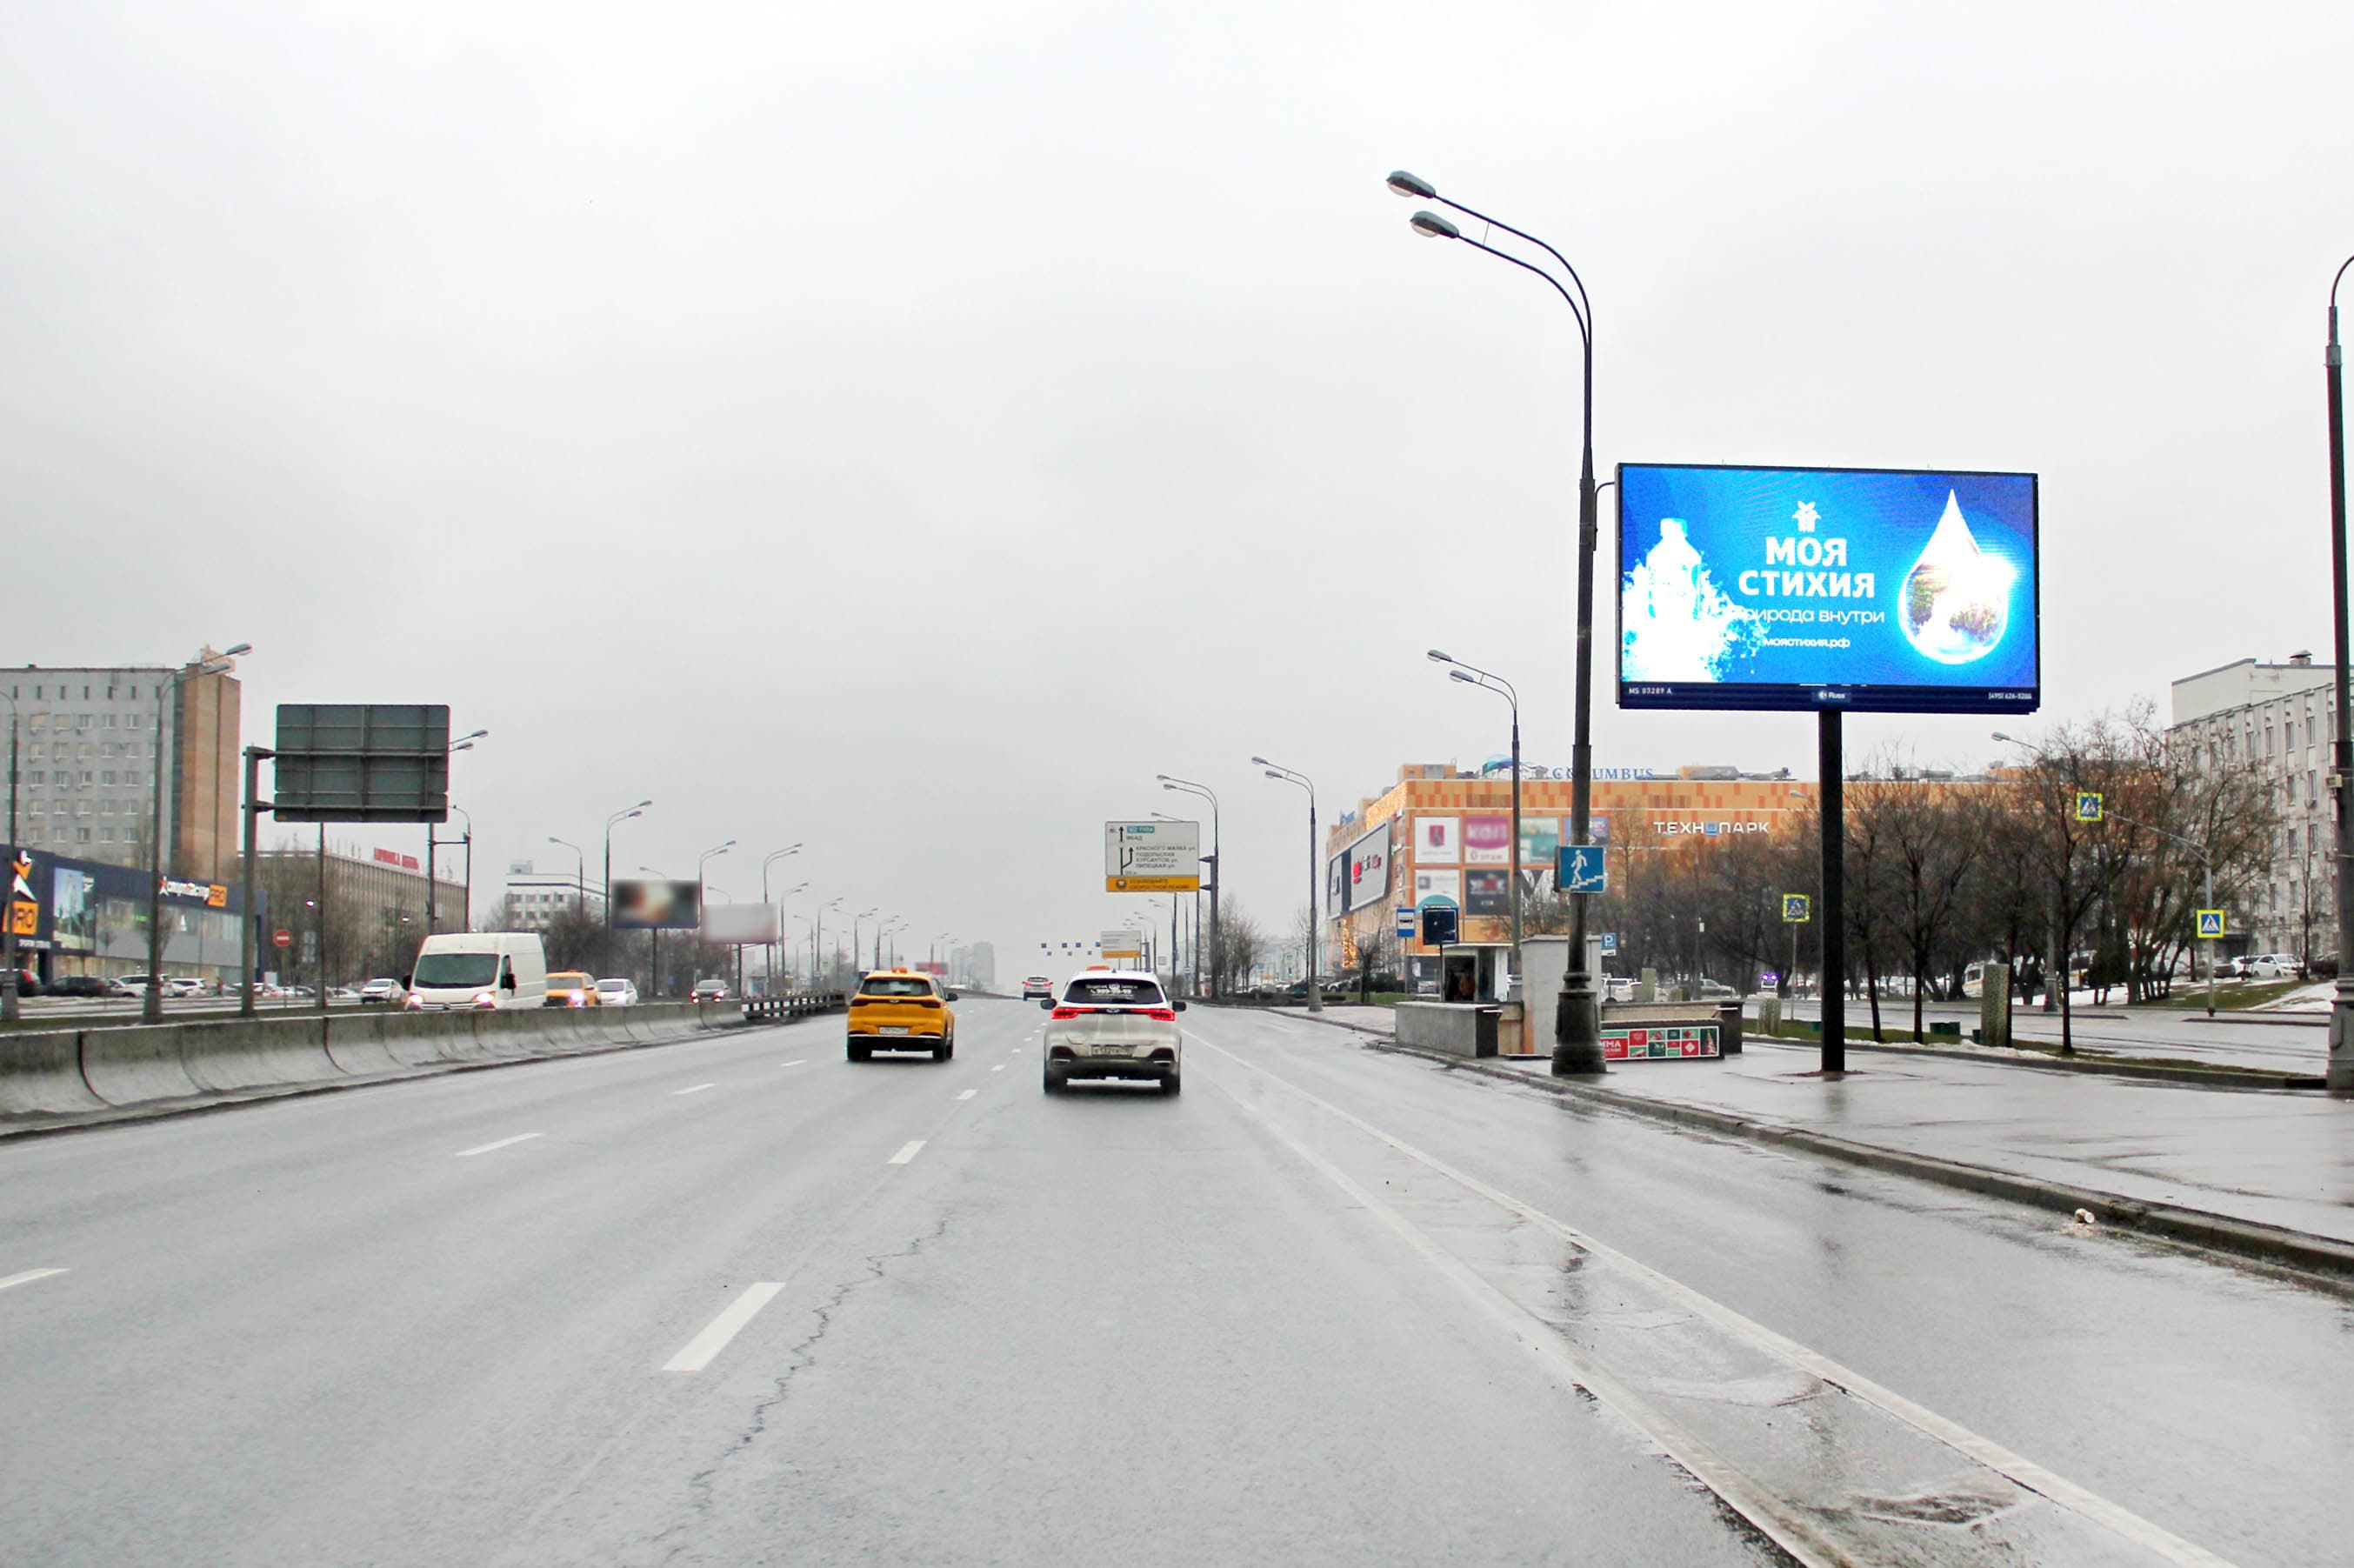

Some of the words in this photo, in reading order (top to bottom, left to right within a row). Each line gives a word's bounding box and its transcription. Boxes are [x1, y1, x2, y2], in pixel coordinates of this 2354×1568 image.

[1765, 536, 1848, 567] МОЯ
[1738, 570, 1875, 598] СТИХИЯ
[1734, 608, 1815, 624] рирода
[1818, 610, 1885, 625] внутри
[1551, 767, 1656, 781] COUMBUS
